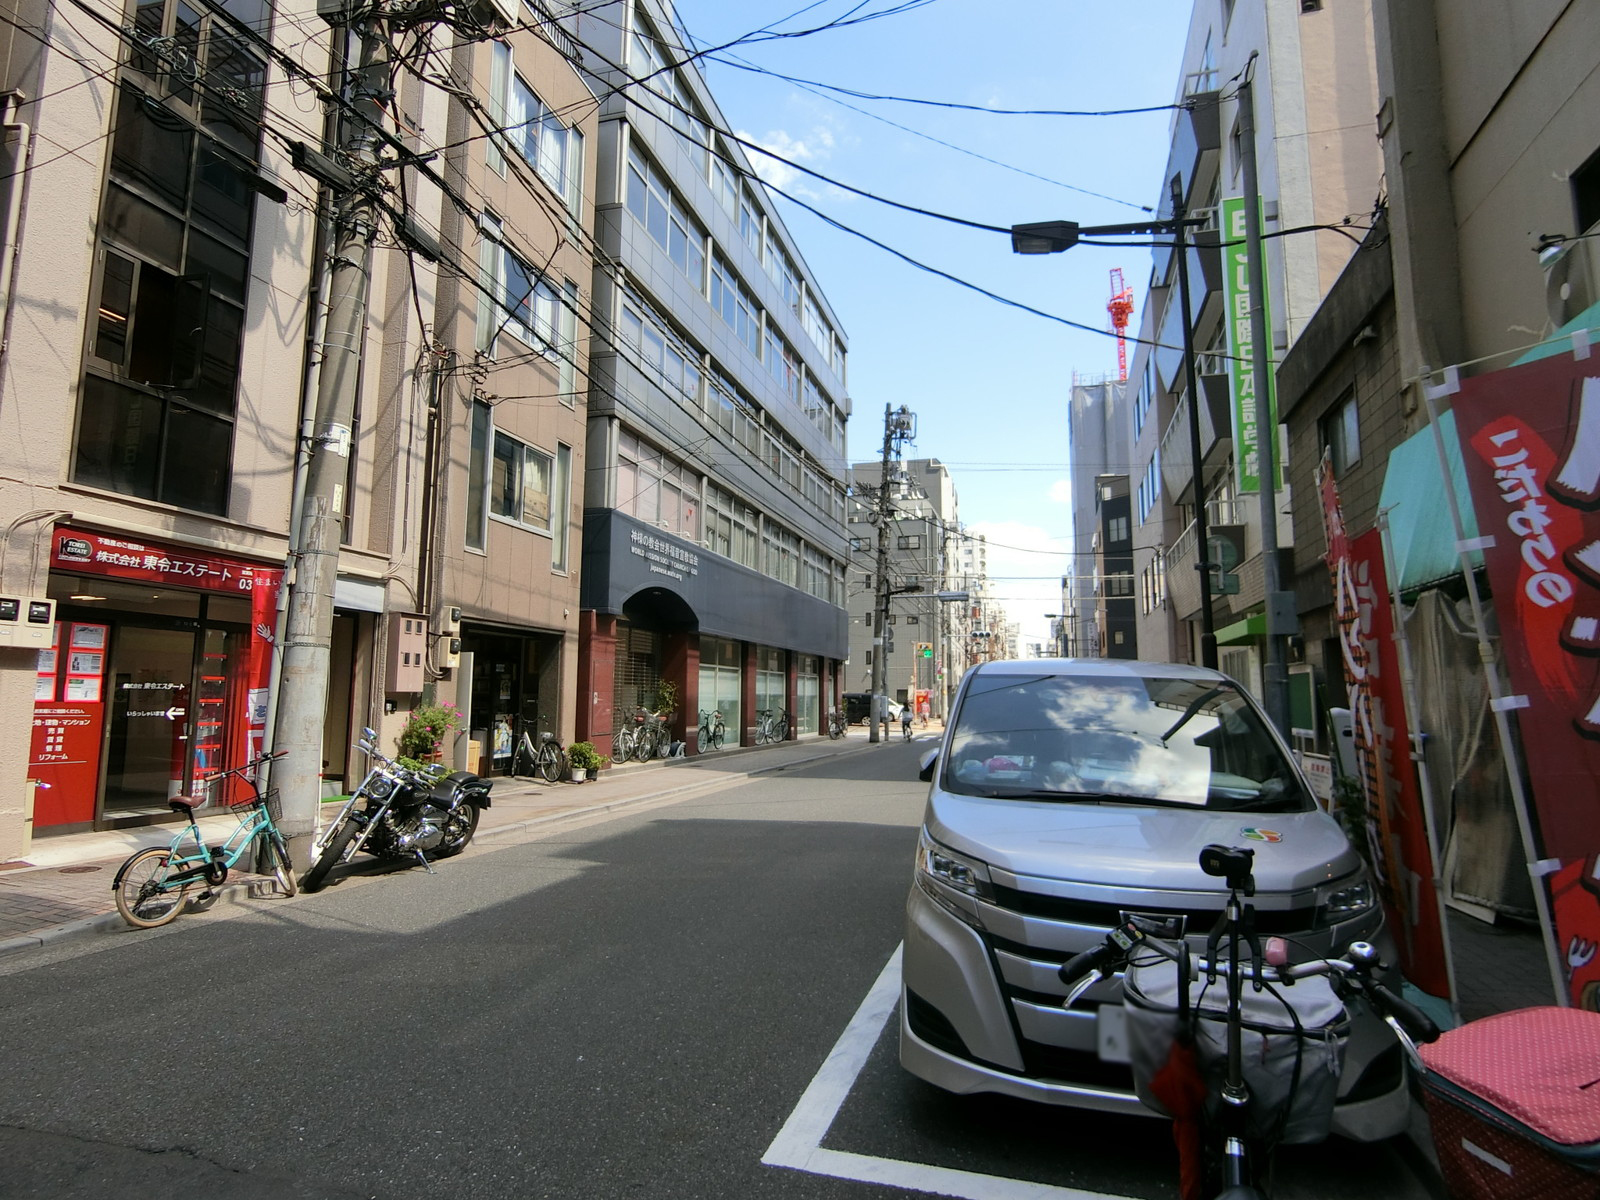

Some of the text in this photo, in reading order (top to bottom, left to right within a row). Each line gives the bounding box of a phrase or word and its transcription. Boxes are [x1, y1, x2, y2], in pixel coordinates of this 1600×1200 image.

[68, 541, 86, 549] TOREI
[67, 546, 88, 555] ESTATE
[96, 550, 232, 582] 株式会社 東令エステート
[239, 578, 253, 591] 03
[143, 682, 185, 690] 東令エステート
[38, 753, 69, 761] リフォーム
